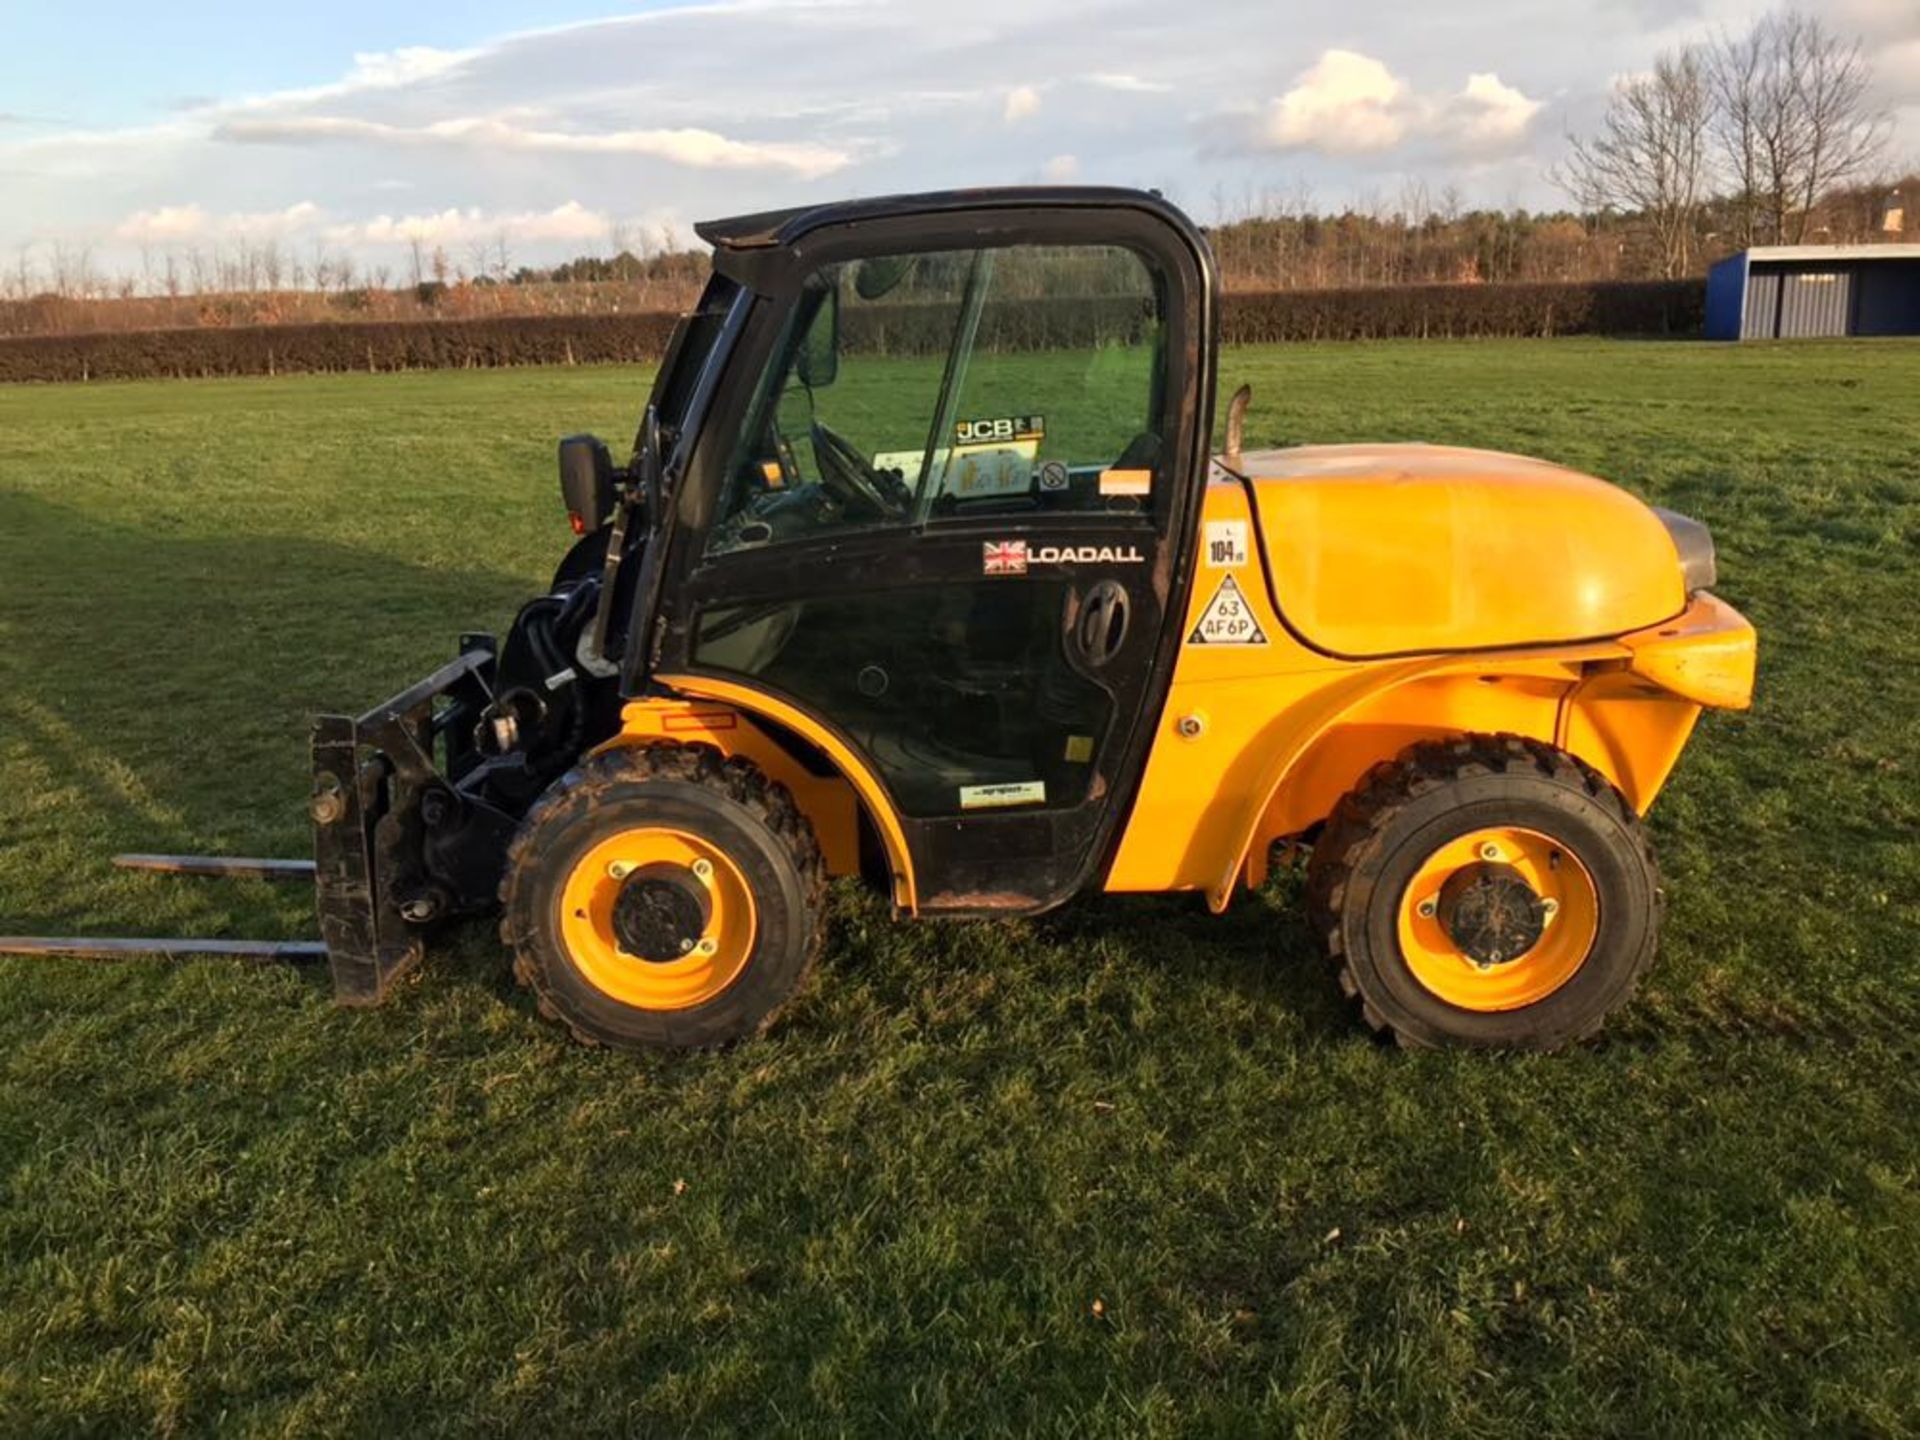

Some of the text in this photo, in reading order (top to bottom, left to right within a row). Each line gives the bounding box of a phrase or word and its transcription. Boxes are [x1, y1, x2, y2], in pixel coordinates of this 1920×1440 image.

[957, 419, 1013, 439] JCB
[1026, 547, 1145, 563] LOADALL
[1210, 540, 1234, 562] 104
[1218, 601, 1239, 616] 63
